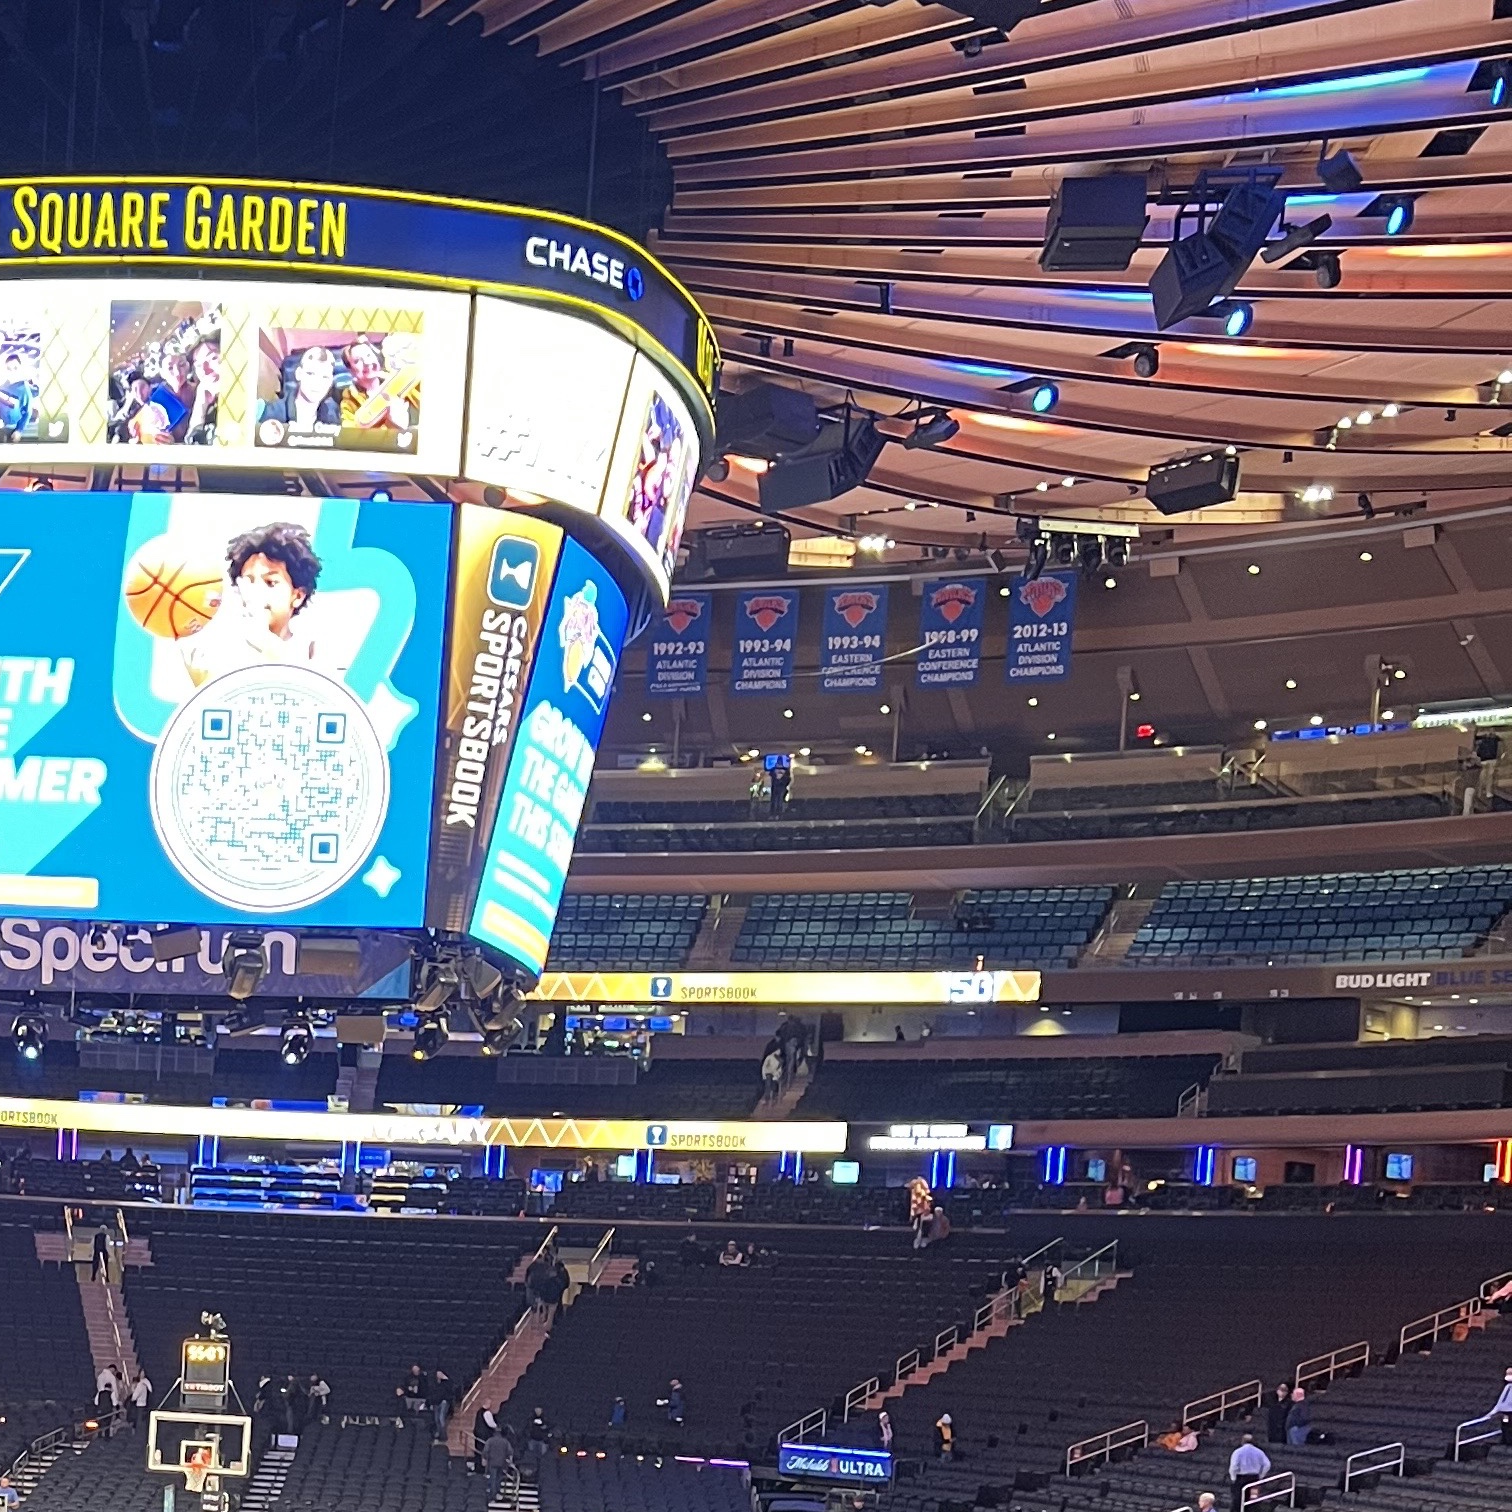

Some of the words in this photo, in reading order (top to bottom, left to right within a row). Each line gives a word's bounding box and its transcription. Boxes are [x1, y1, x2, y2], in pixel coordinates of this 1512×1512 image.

[11, 186, 170, 254] SQUARE
[185, 186, 347, 258] GARDEN
[525, 236, 624, 291] CHASE
[1013, 622, 1068, 639] 2012-13
[653, 641, 705, 656] 1992-93
[739, 639, 791, 653] 1993-94
[828, 635, 881, 650] 1993-94
[1017, 641, 1061, 653] ATLANTIC
[831, 653, 873, 664] EASTERN
[928, 647, 970, 659] EASTERN
[1018, 653, 1058, 665] DIVISION
[656, 659, 697, 670] ATLANTIC
[742, 657, 784, 667] ATLANTIC
[917, 659, 978, 672] CONFERENCE
[658, 671, 695, 681] DIVISION
[743, 669, 781, 679] DIVISION
[920, 670, 973, 683] CHAMPIONS
[1009, 665, 1064, 677] CHAMPIONS
[492, 615, 527, 747] CAESARS
[735, 680, 787, 691] CHAMPIONS
[824, 677, 876, 688] CHAMPIONS
[446, 609, 512, 829] SPORTSBOOK
[1335, 974, 1374, 988] BUD
[1376, 972, 1431, 987] LIGHT
[1435, 970, 1485, 985] BLUE
[680, 986, 757, 1000] SPORTSBOOK
[670, 1133, 746, 1148] SPORTSBOOK
[839, 1461, 884, 1476] ULTRA
